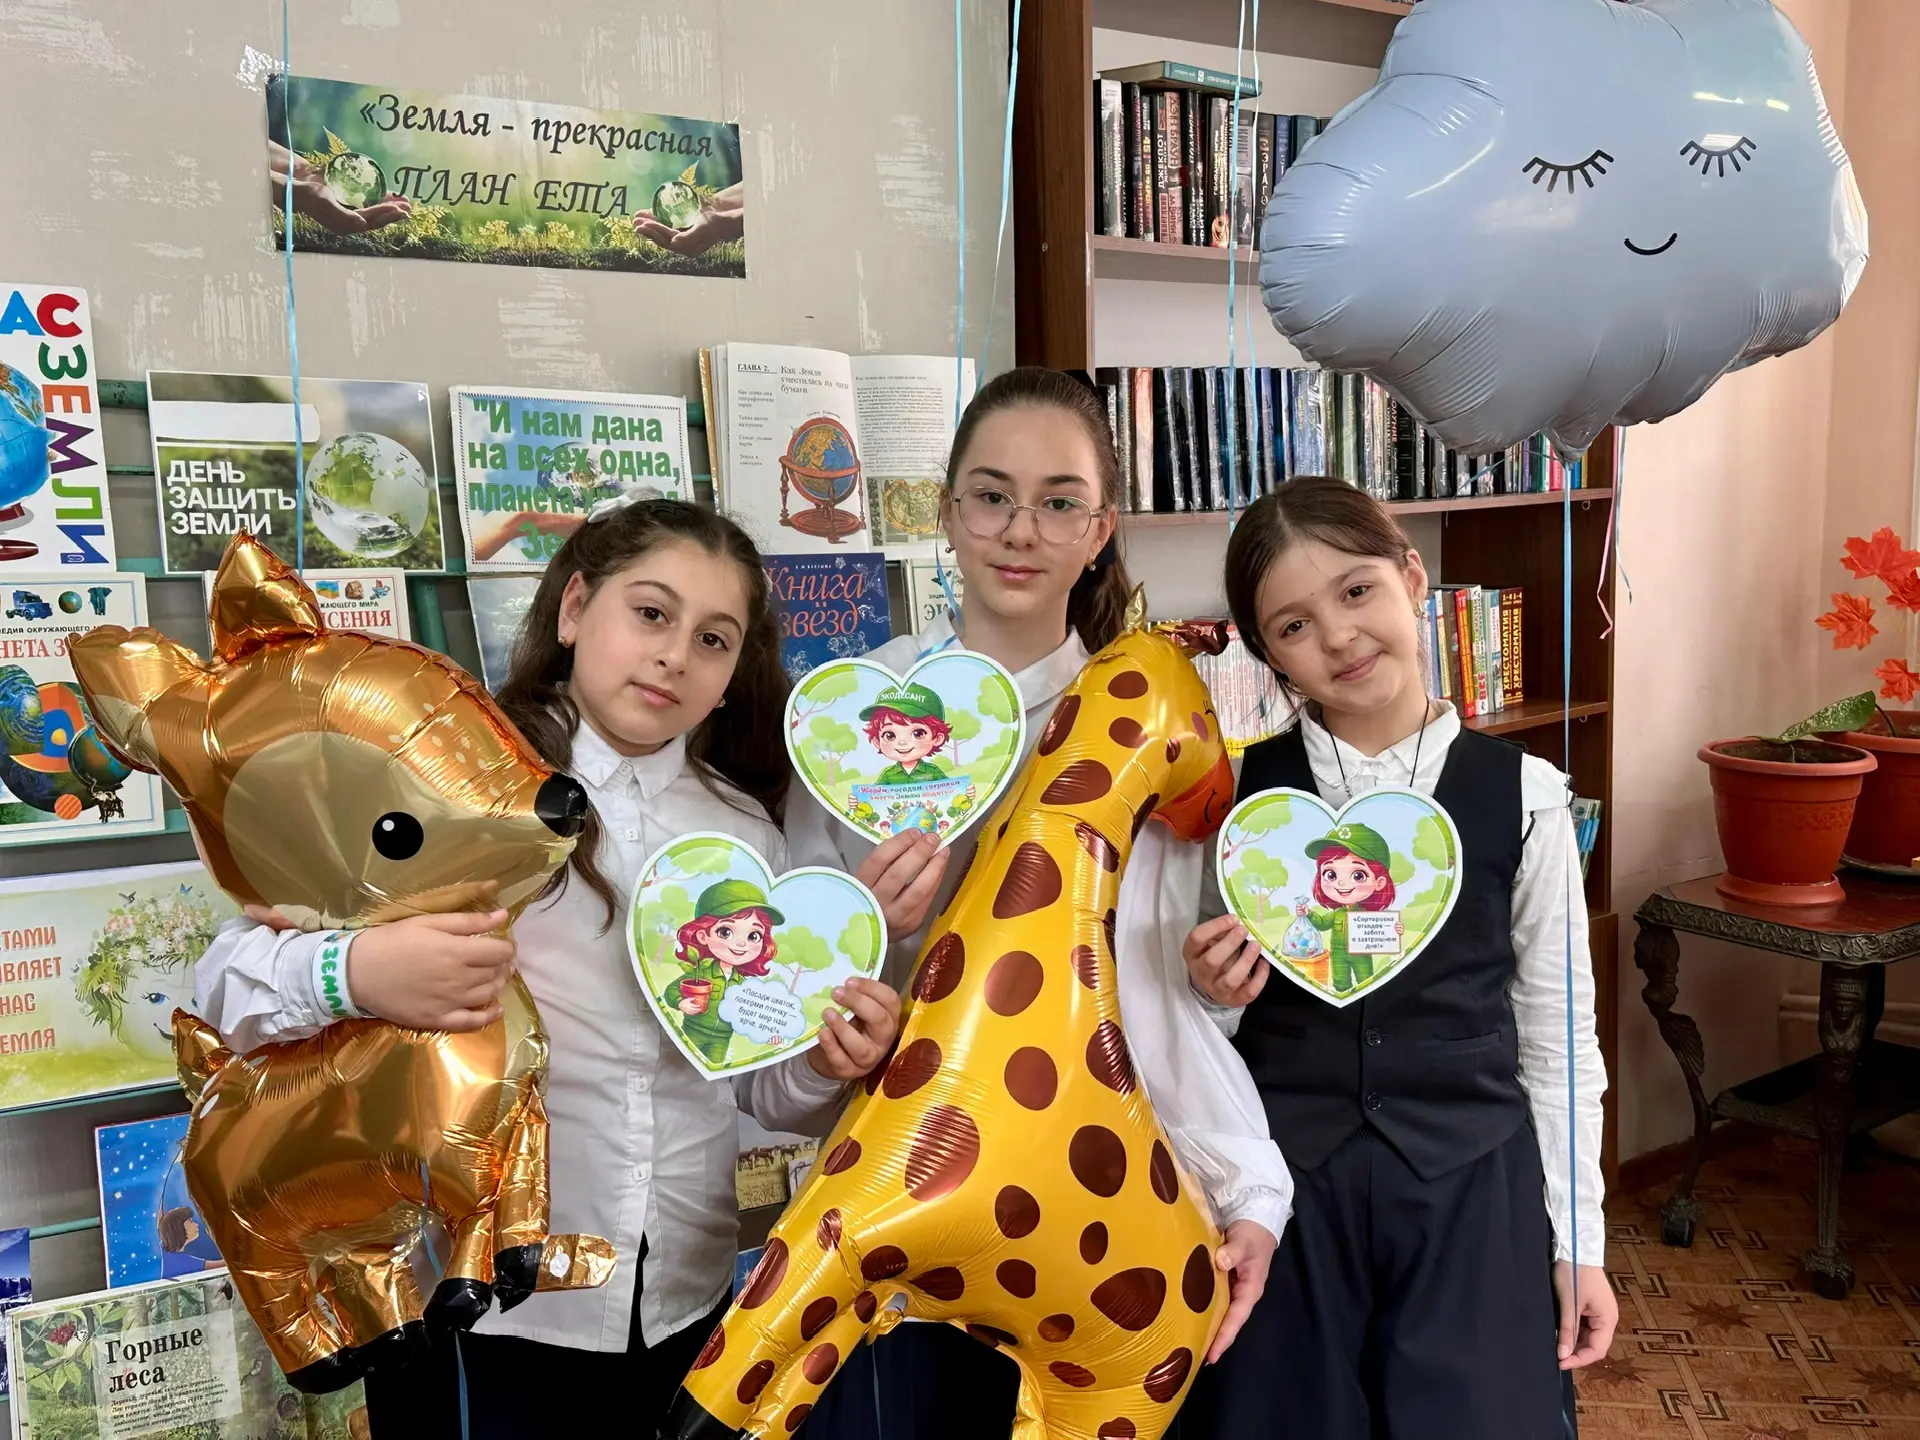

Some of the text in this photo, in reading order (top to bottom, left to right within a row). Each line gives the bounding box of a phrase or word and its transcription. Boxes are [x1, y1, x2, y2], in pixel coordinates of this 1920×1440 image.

[360, 94, 490, 137] «Земля
[532, 116, 713, 160] прекрасная
[1157, 134, 1166, 189] ДЖЕКПОТ
[393, 165, 631, 217] ПЛАН ЕТА
[737, 363, 762, 372] ГЛАВА
[781, 366, 797, 375] Как
[522, 410, 582, 438] нам
[592, 414, 663, 445] дана
[38, 341, 109, 564] ЗЕМЛИ
[468, 442, 681, 486] на всех одна,
[166, 460, 246, 487] ДЕНЬ
[468, 482, 583, 514] планета
[170, 511, 272, 535] ЗЕМЛИ
[767, 566, 864, 601] Книга
[26, 625, 90, 634] ОКРУЖАЮЩЕГО
[779, 599, 860, 638] звёзд
[1502, 609, 1510, 690] ХРЕСТОМАТИЯ
[1512, 608, 1520, 689] ХРЕСТОМАТИЯ
[0, 925, 56, 951] ТАМИ
[0, 956, 61, 983] ВЛЯЕТ
[0, 992, 36, 1016] НАС
[105, 1328, 203, 1364] Горные
[109, 1366, 167, 1393] леса
